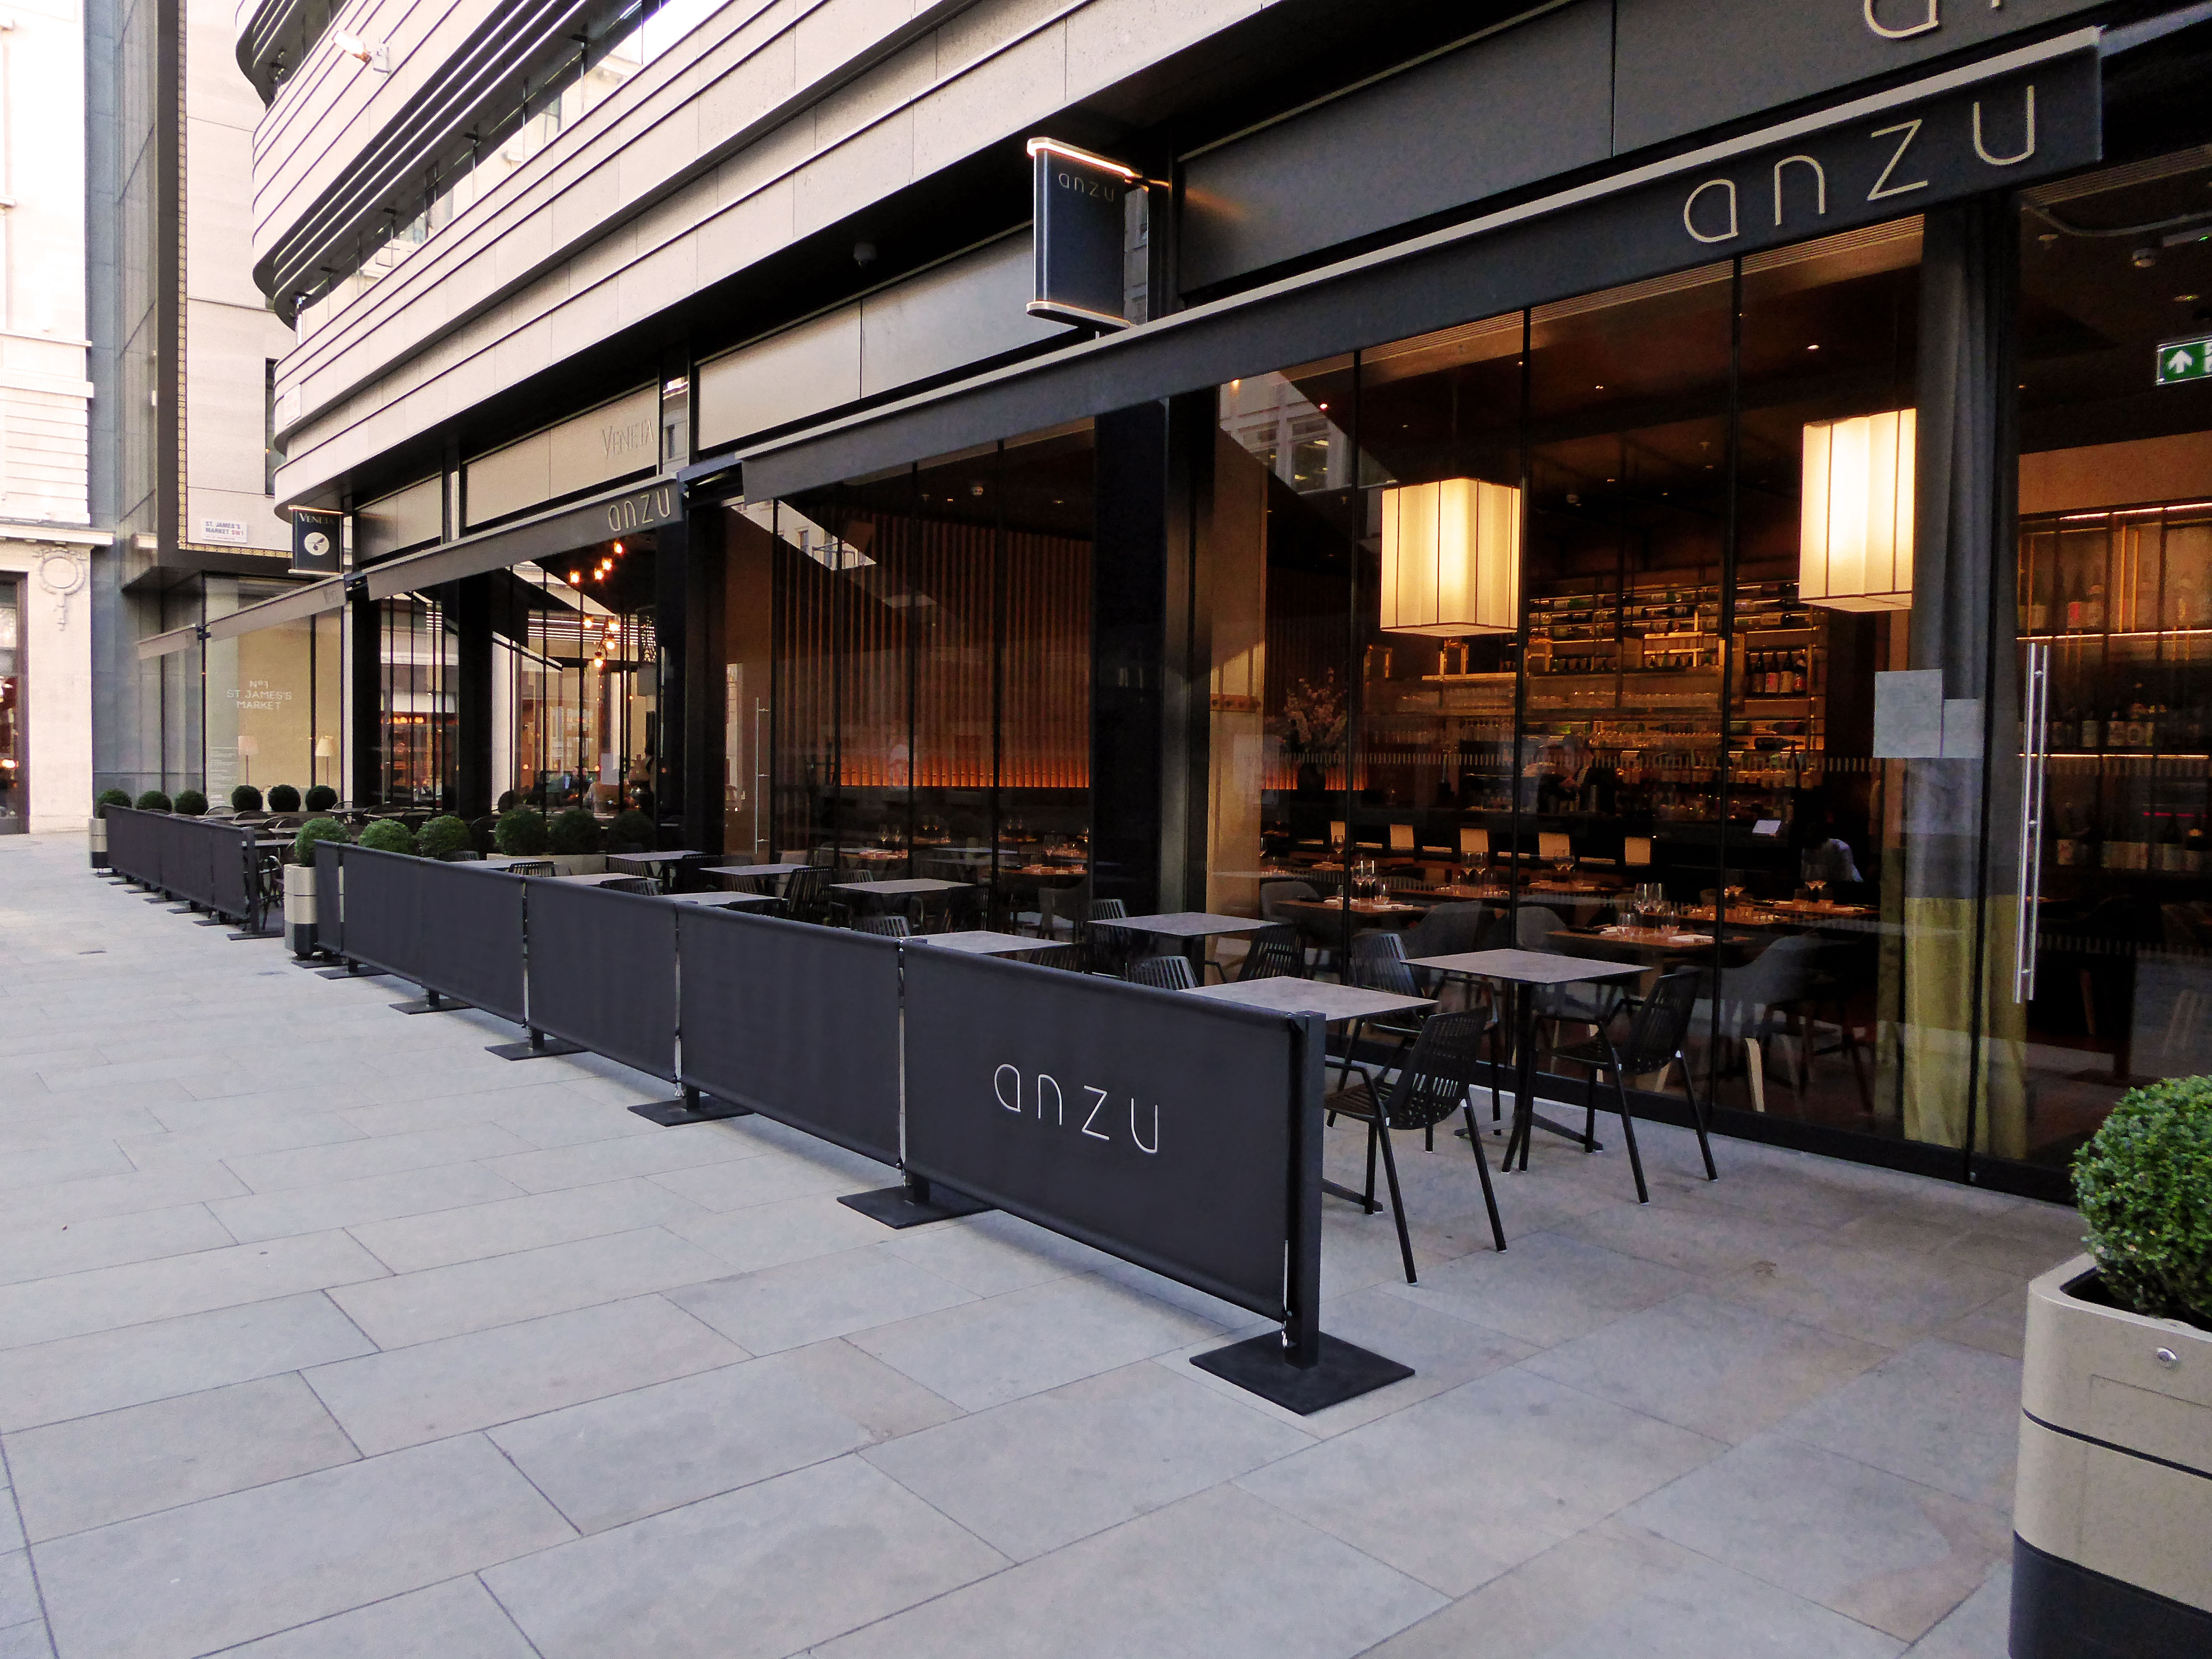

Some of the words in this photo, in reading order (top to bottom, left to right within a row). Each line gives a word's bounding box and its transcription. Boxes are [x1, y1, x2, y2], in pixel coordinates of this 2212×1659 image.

[1684, 85, 2035, 243] anzu
[1059, 173, 1114, 202] anzu
[602, 418, 654, 459] VENETA
[609, 488, 670, 531] anzu
[227, 689, 240, 698] ST
[236, 701, 281, 711] MARKET
[994, 1064, 1158, 1153] anzu
